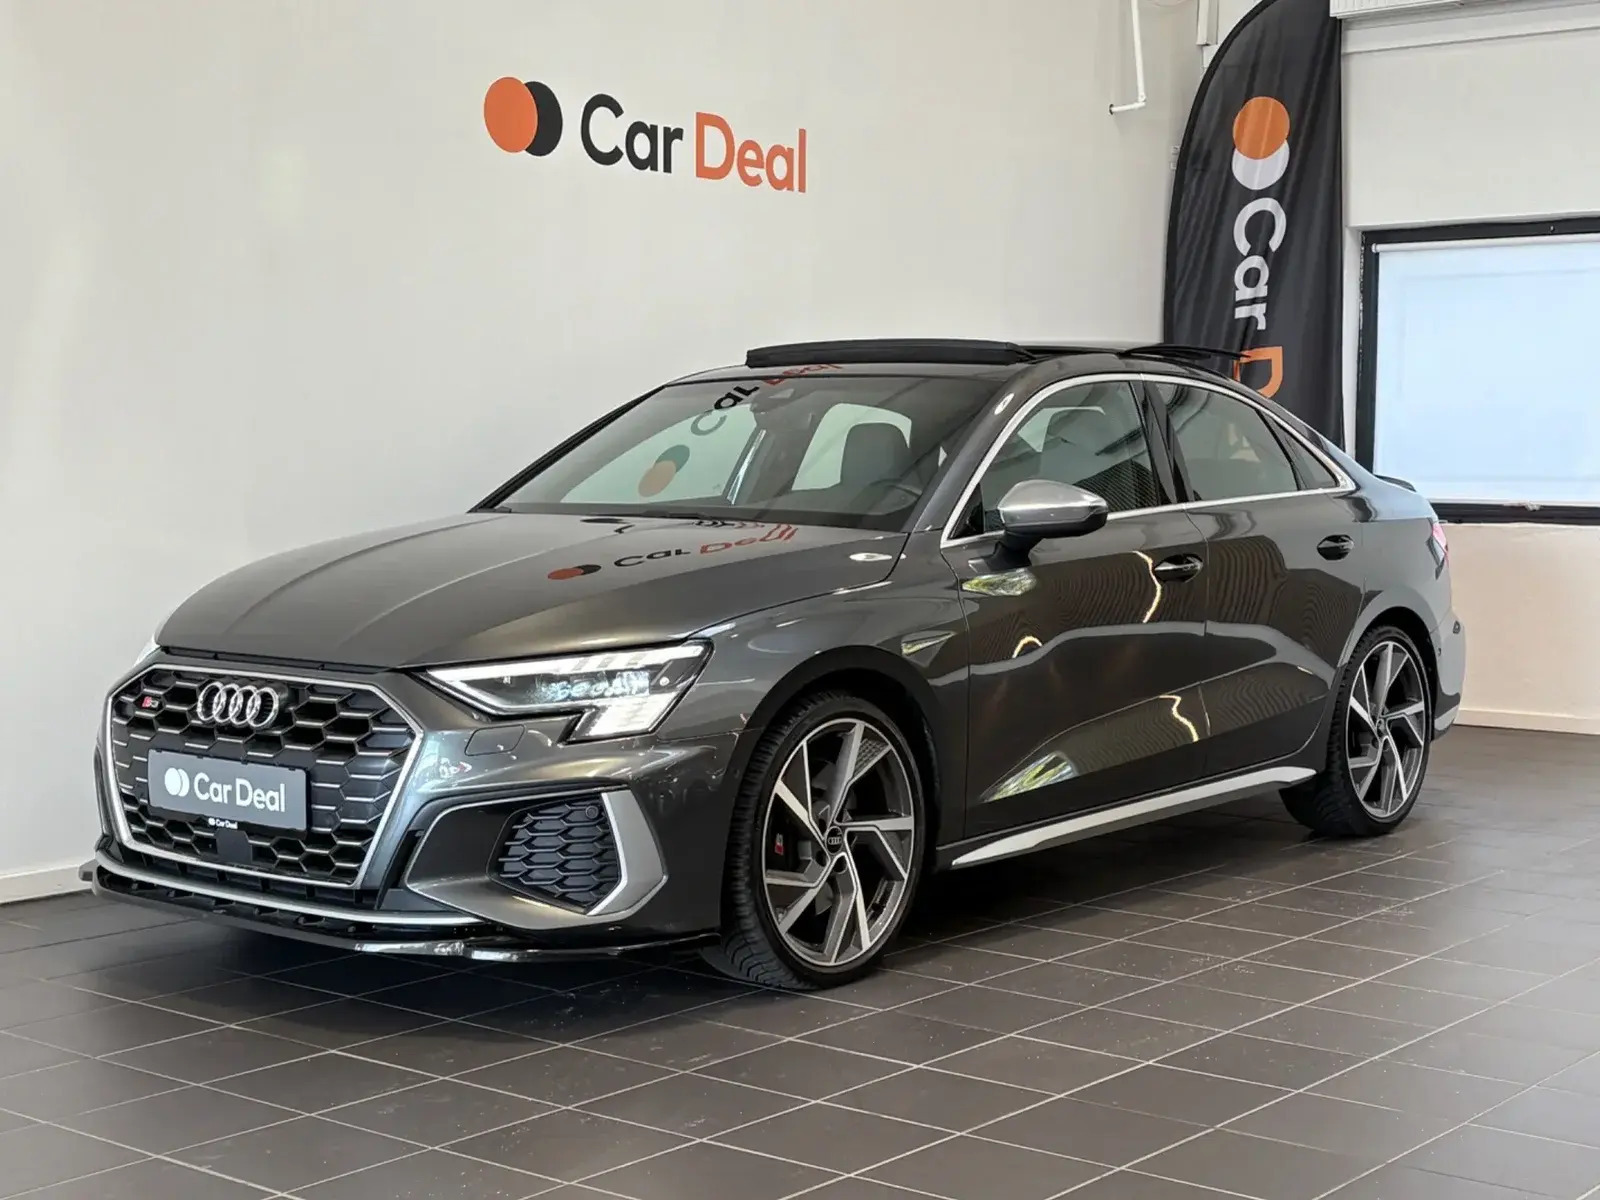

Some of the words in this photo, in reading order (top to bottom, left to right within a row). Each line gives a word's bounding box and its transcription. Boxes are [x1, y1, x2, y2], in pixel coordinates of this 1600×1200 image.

[580, 93, 684, 174] Car
[695, 111, 807, 193] Deal
[1232, 197, 1287, 331] Car
[193, 772, 232, 804] Car
[235, 777, 286, 812] Deal
